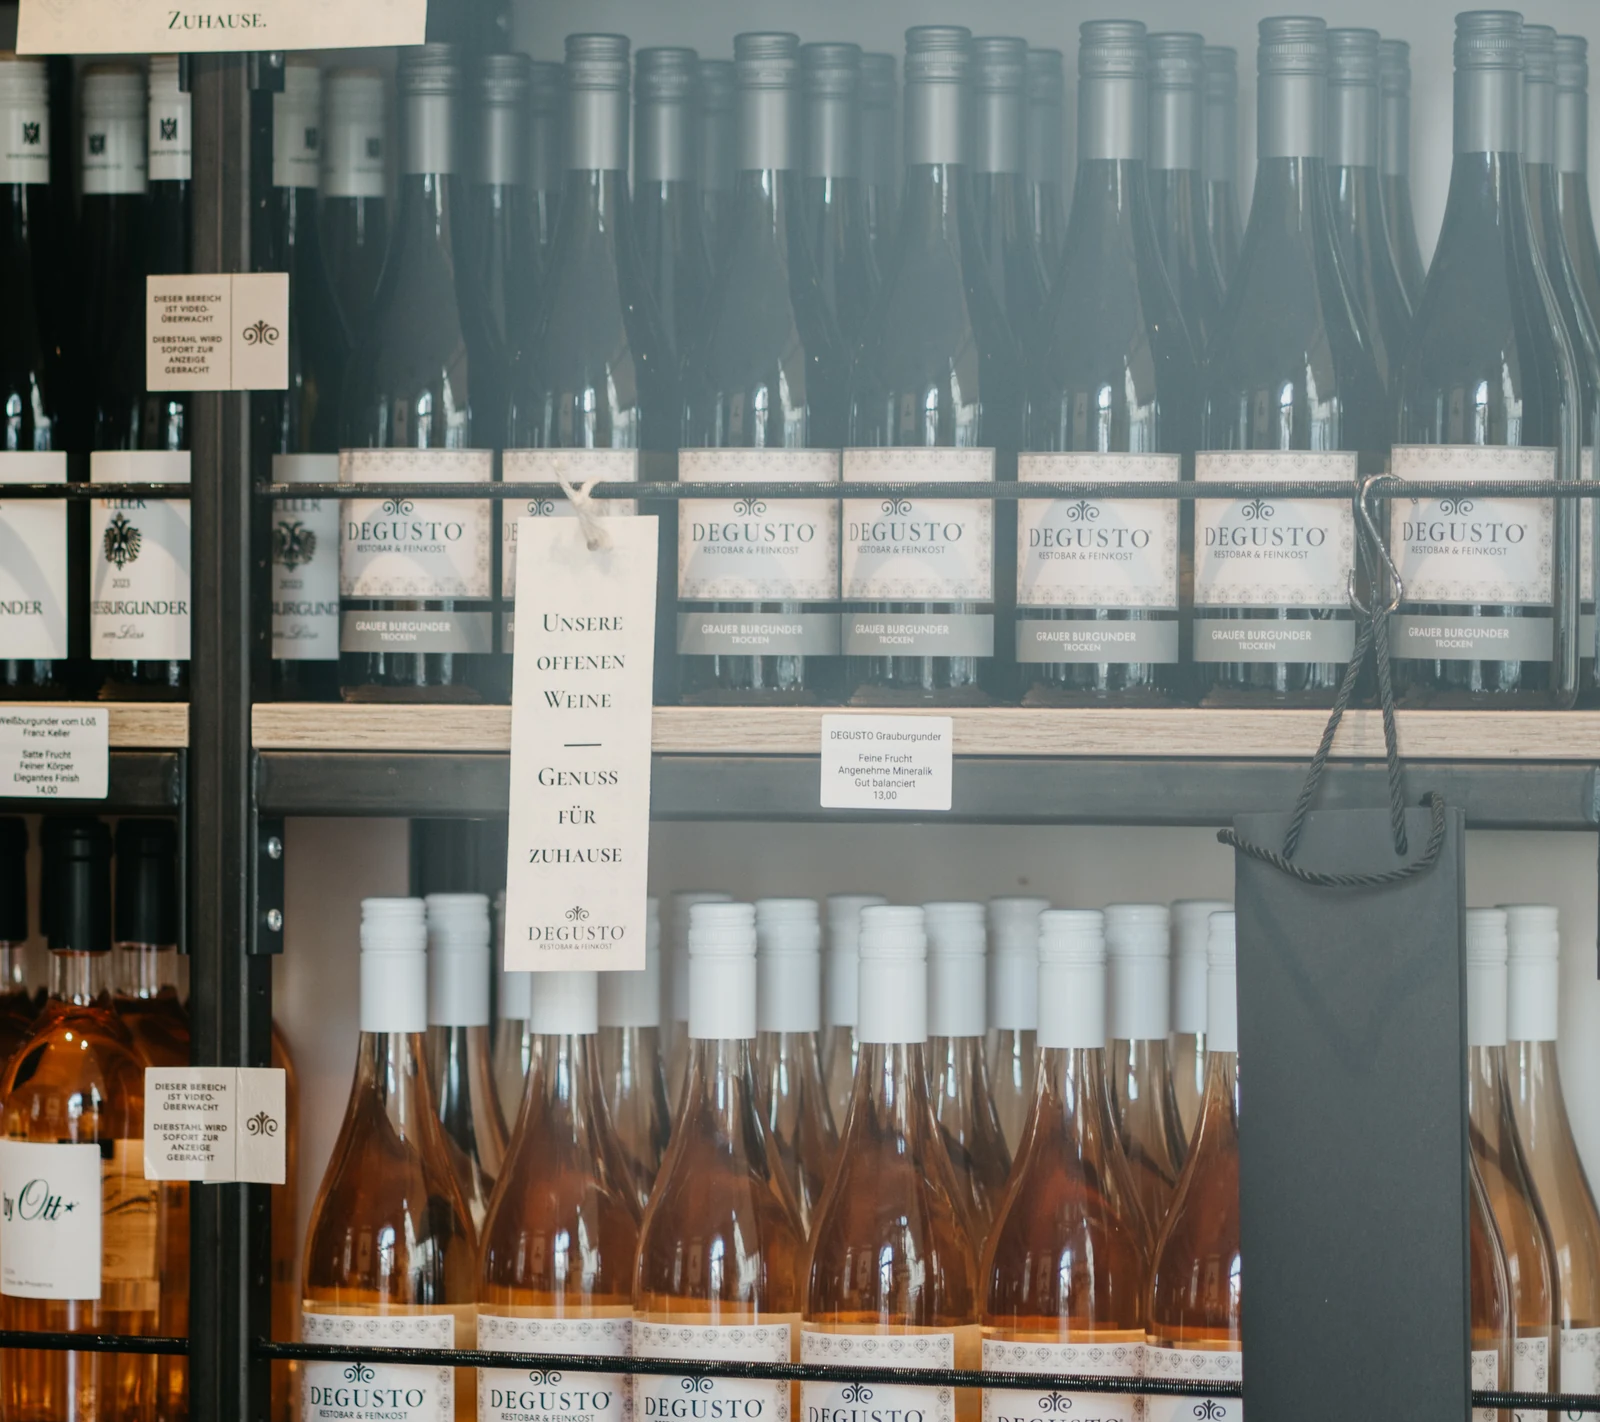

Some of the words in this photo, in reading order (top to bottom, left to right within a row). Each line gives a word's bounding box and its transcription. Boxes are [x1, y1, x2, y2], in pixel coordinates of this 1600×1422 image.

[154, 295, 183, 303] DIESER
[165, 305, 177, 313] IST
[180, 305, 209, 313] VIDEO-
[161, 315, 213, 323] ÜBERWACHT
[165, 366, 210, 374] GEBRACHT
[348, 522, 463, 541] DEGUSTO
[692, 523, 814, 542] DEGUSTO
[849, 522, 963, 543] DEGUSTO
[1403, 522, 1524, 544] DEGUSTO
[1029, 528, 1149, 549] DEGUSTO
[1205, 527, 1325, 548] DEGUSTO
[703, 546, 744, 554] RESTOBAR
[756, 546, 799, 554] FEINKOST
[702, 624, 738, 634] GRAUER
[740, 624, 803, 634] BURGUNDER
[1408, 627, 1443, 639] GRAUER
[1445, 628, 1510, 639] BURGUNDER
[732, 636, 769, 644] TROCKEN
[1036, 632, 1070, 643] GRAUER
[1072, 632, 1136, 643] BURGUNDER
[1211, 630, 1245, 641] GRAUER
[1247, 630, 1312, 641] BURGUNDER
[47, 728, 71, 737] Keller
[830, 731, 874, 740] DEGUSTO
[876, 731, 942, 743] Grauburgunder
[45, 750, 72, 759] Frucht
[858, 754, 882, 763] Feine
[885, 754, 913, 763] Frucht
[20, 761, 44, 770] Feiner
[47, 761, 74, 771] Körper
[838, 766, 891, 777] Angenehme
[892, 766, 933, 776] Mineralik
[855, 778, 870, 787] Gut
[872, 778, 916, 788] balanciert
[873, 790, 897, 800] 13,00
[529, 848, 622, 864] ZUHAUSE
[528, 926, 624, 941] DEGUSTO
[155, 1083, 187, 1091] DIESER
[168, 1093, 181, 1101] IST
[163, 1102, 219, 1111] ÜBERWACHT
[153, 1123, 202, 1131] DIEBSTAHL
[204, 1124, 227, 1132] WIRD
[163, 1133, 199, 1141] SOFORT
[310, 1386, 423, 1408] DEGUSTO
[491, 1389, 610, 1411] DEGUSTO
[645, 1397, 763, 1418] DEGUSTO
